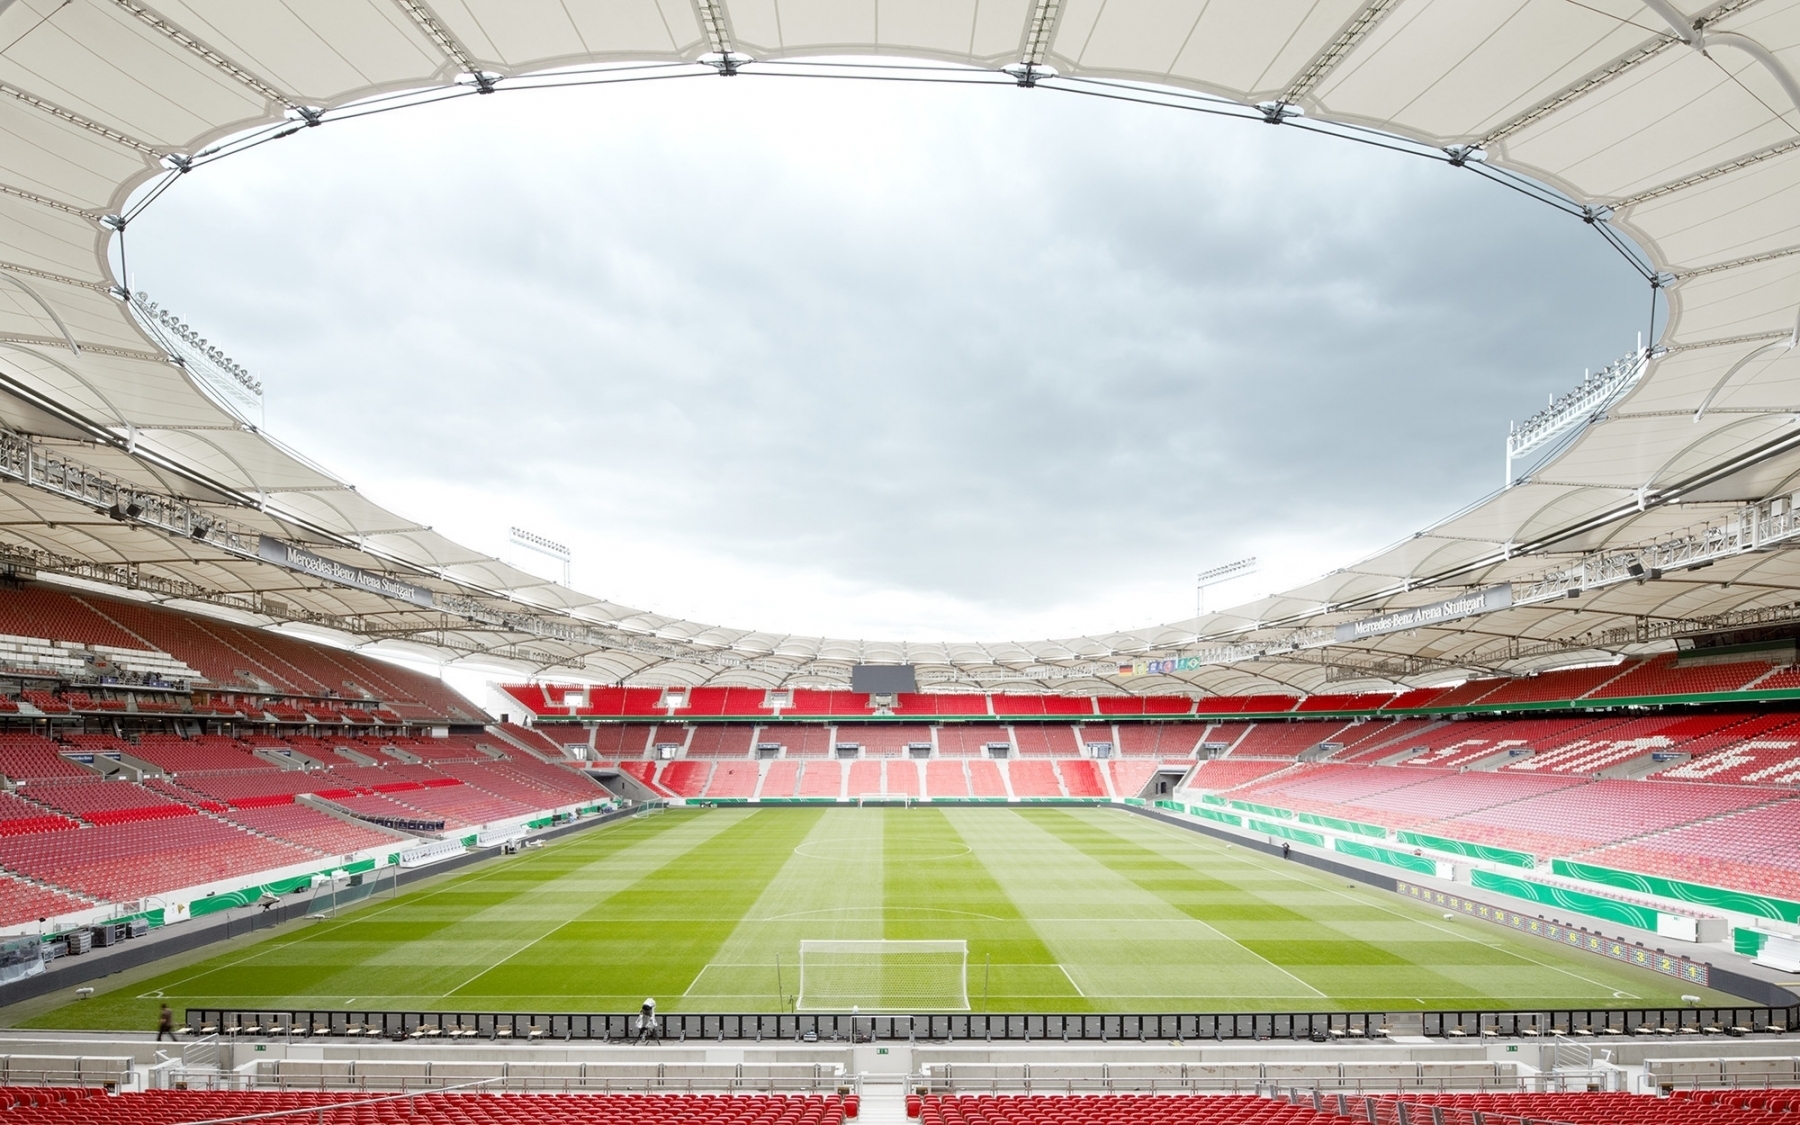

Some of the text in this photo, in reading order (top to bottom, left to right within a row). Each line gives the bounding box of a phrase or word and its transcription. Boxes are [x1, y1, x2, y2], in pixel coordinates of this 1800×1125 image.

[287, 548, 415, 600] Mercedes-Benz Arena Stuttgart
[1355, 594, 1485, 634] Mercedes-Benz Arena Stuttgart
[1464, 901, 1473, 911] 12
[1480, 906, 1487, 916] 11
[1495, 910, 1504, 921] 10
[1513, 916, 1519, 925] 9
[1531, 921, 1538, 931] 8
[1550, 926, 1556, 936] 7
[1569, 932, 1577, 942] 6
[1590, 938, 1597, 949] 5
[1613, 945, 1620, 955] 4
[1637, 951, 1645, 962] 3
[1662, 959, 1670, 970] 2
[1688, 966, 1696, 977] 1
